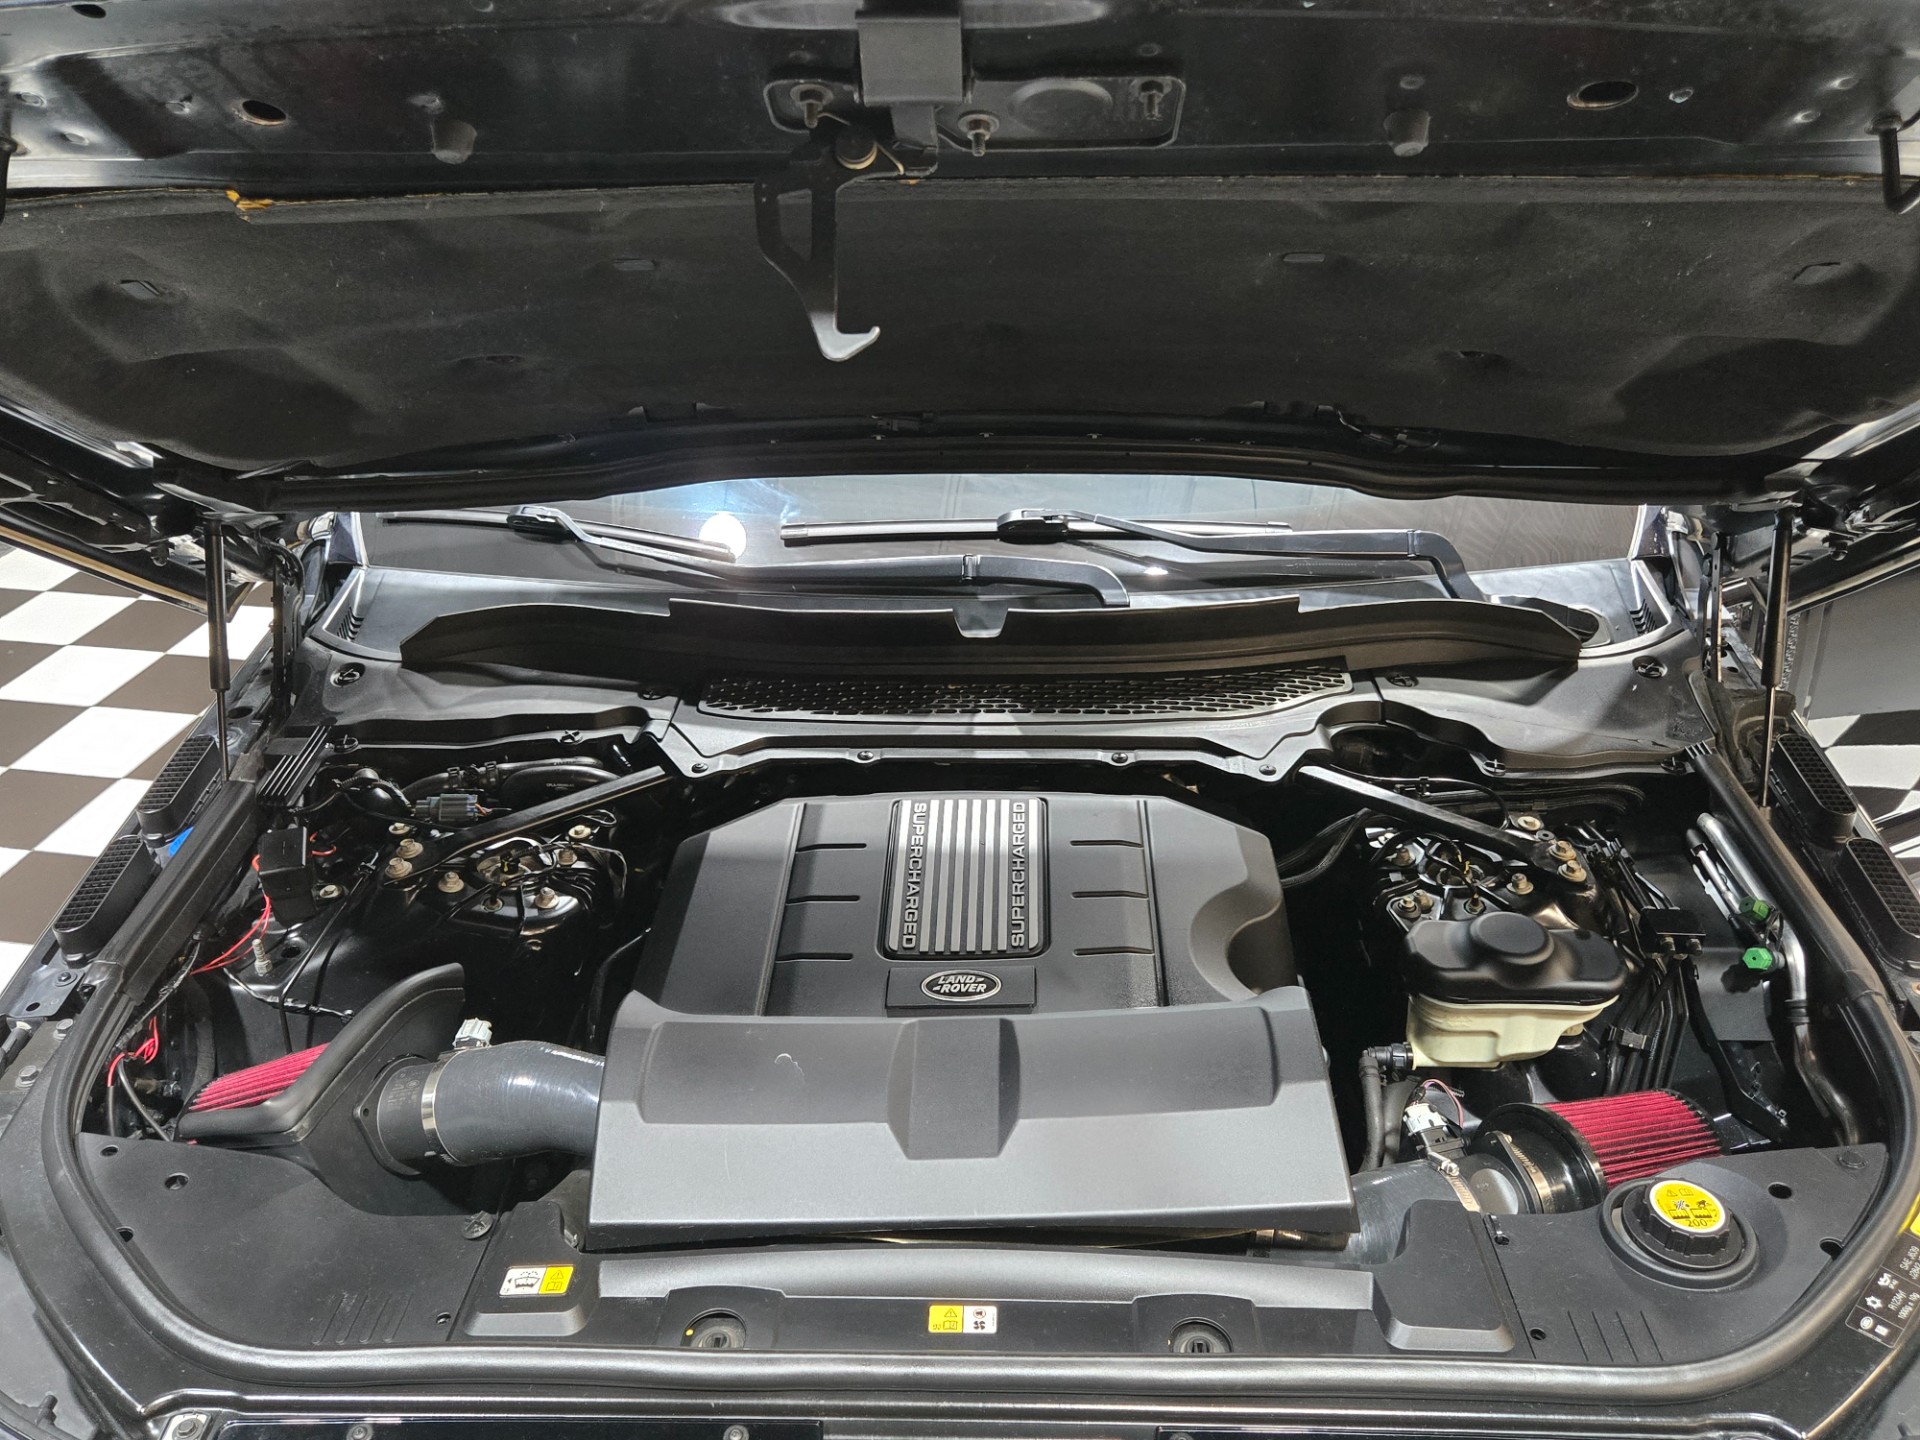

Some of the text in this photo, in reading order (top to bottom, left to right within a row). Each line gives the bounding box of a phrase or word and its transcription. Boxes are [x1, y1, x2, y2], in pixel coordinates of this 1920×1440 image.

[902, 802, 927, 949] SUPERCHARGED
[1011, 802, 1026, 947] SUPERCHARGED
[937, 975, 976, 985] LAND
[939, 984, 987, 993] ROVER
[1686, 1219, 1708, 1227] 200
